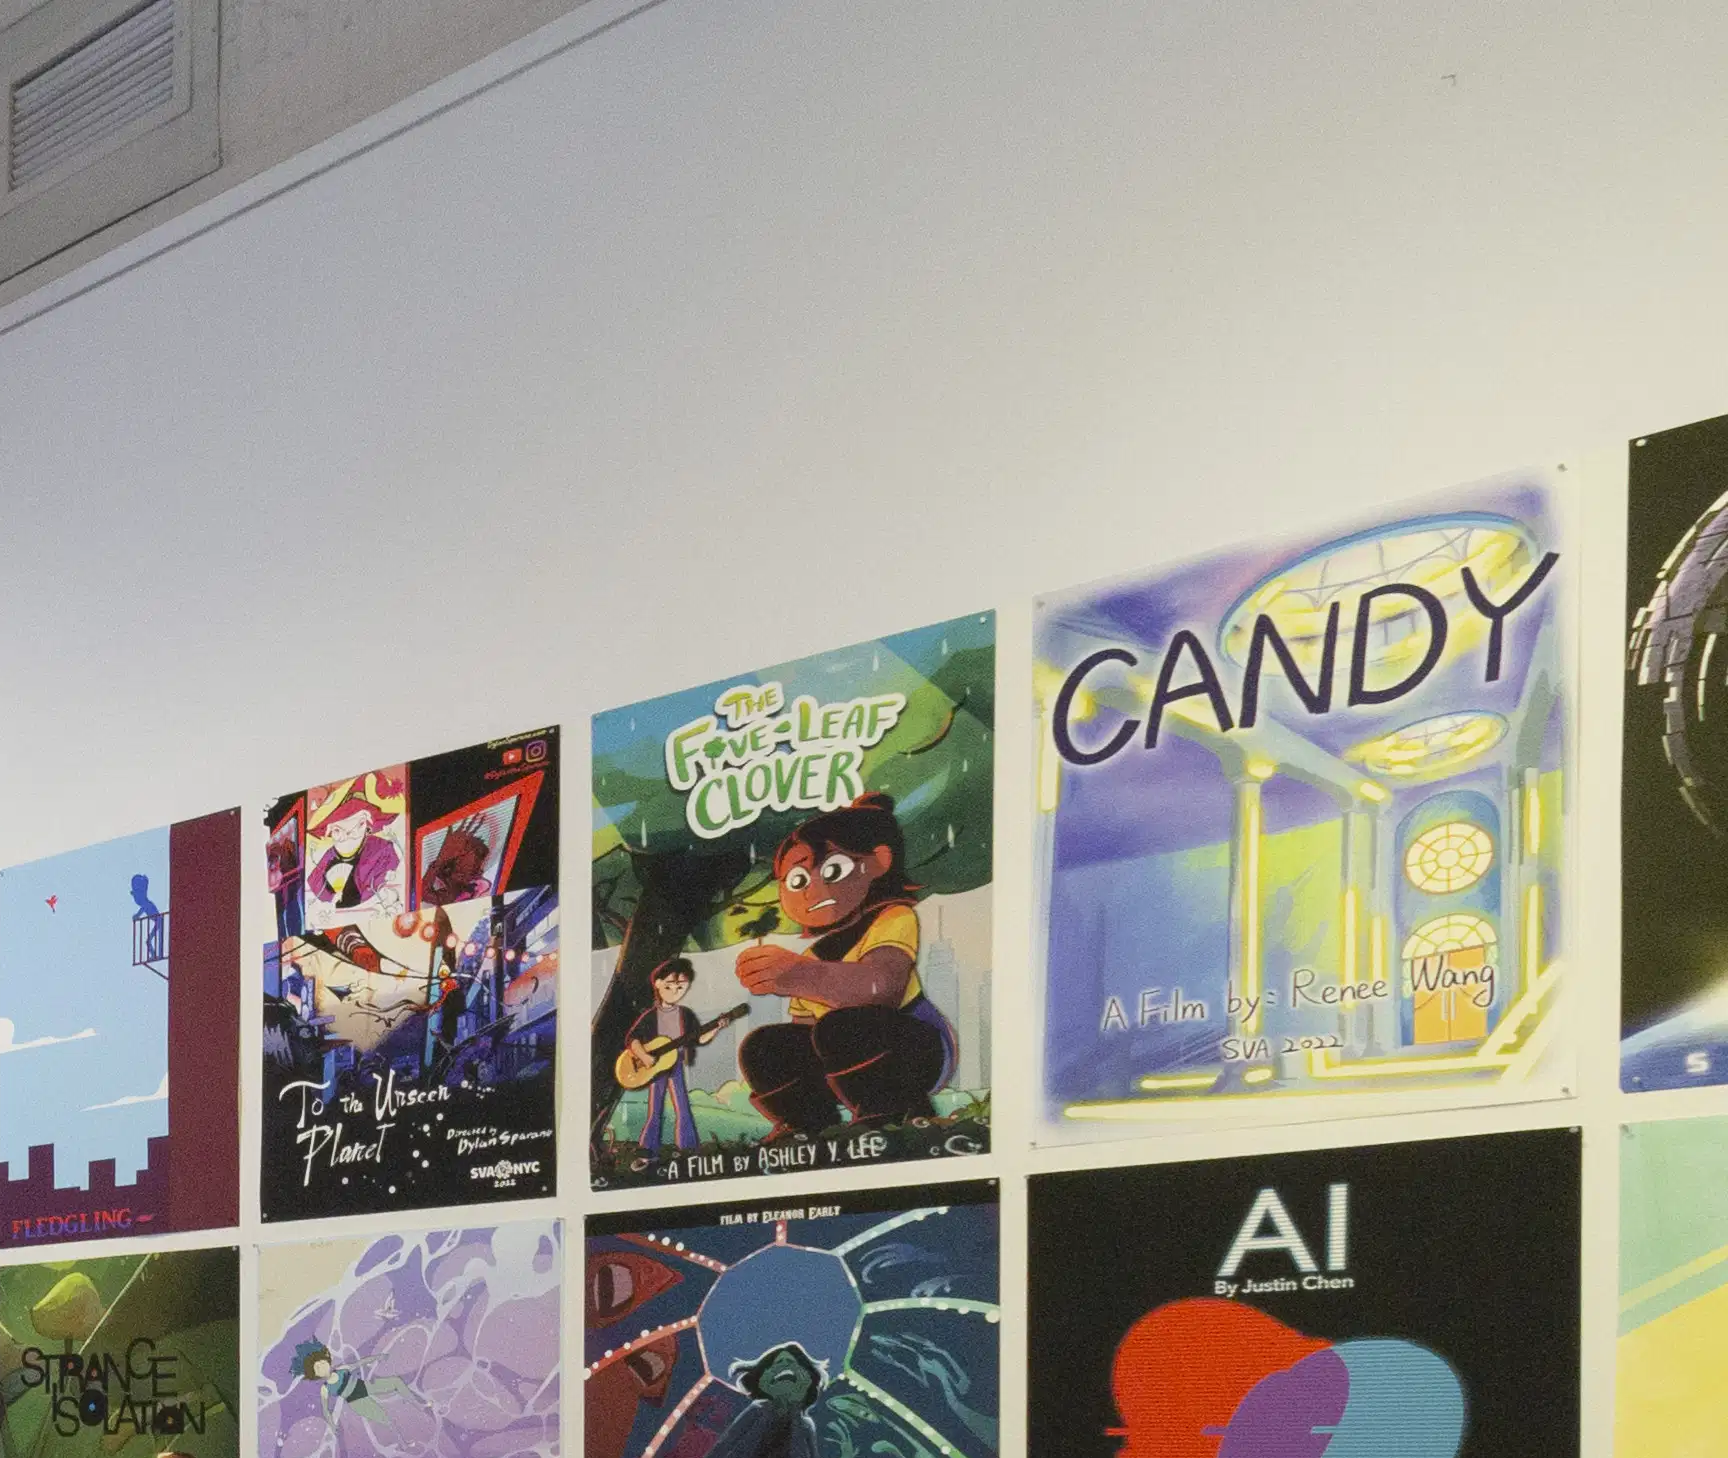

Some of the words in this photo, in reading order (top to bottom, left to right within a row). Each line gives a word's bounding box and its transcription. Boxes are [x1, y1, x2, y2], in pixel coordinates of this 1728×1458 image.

[1051, 552, 1559, 766] CANDY
[723, 687, 777, 720] THE
[695, 751, 855, 830] CLOVER
[1102, 998, 1128, 1032] A
[1139, 990, 1204, 1026] Film
[1291, 968, 1389, 1007] Renee
[1410, 955, 1495, 1008] Wang
[1222, 1038, 1270, 1060] SVA
[1281, 1035, 1343, 1053] 2022
[279, 1080, 331, 1129] To
[340, 1093, 364, 1114] the
[296, 1122, 396, 1187] Planet
[457, 1137, 497, 1156] Dylan
[667, 1161, 679, 1180] A
[688, 1154, 723, 1178] FILM
[734, 1156, 750, 1172] BY
[759, 1144, 816, 1169] ASHLEY
[848, 1136, 884, 1159] LEE
[470, 1165, 496, 1179] SVA
[513, 1161, 541, 1175] NYC
[12, 1207, 132, 1240] FLEDGLING
[720, 1214, 743, 1226] FILM
[747, 1213, 759, 1223] BY
[762, 1208, 805, 1223] ELEANOR
[808, 1205, 842, 1219] EARLY
[1216, 1183, 1349, 1276] AI
[1213, 1279, 1239, 1297] By
[1241, 1276, 1299, 1295] Justin
[1302, 1272, 1355, 1292] Chen
